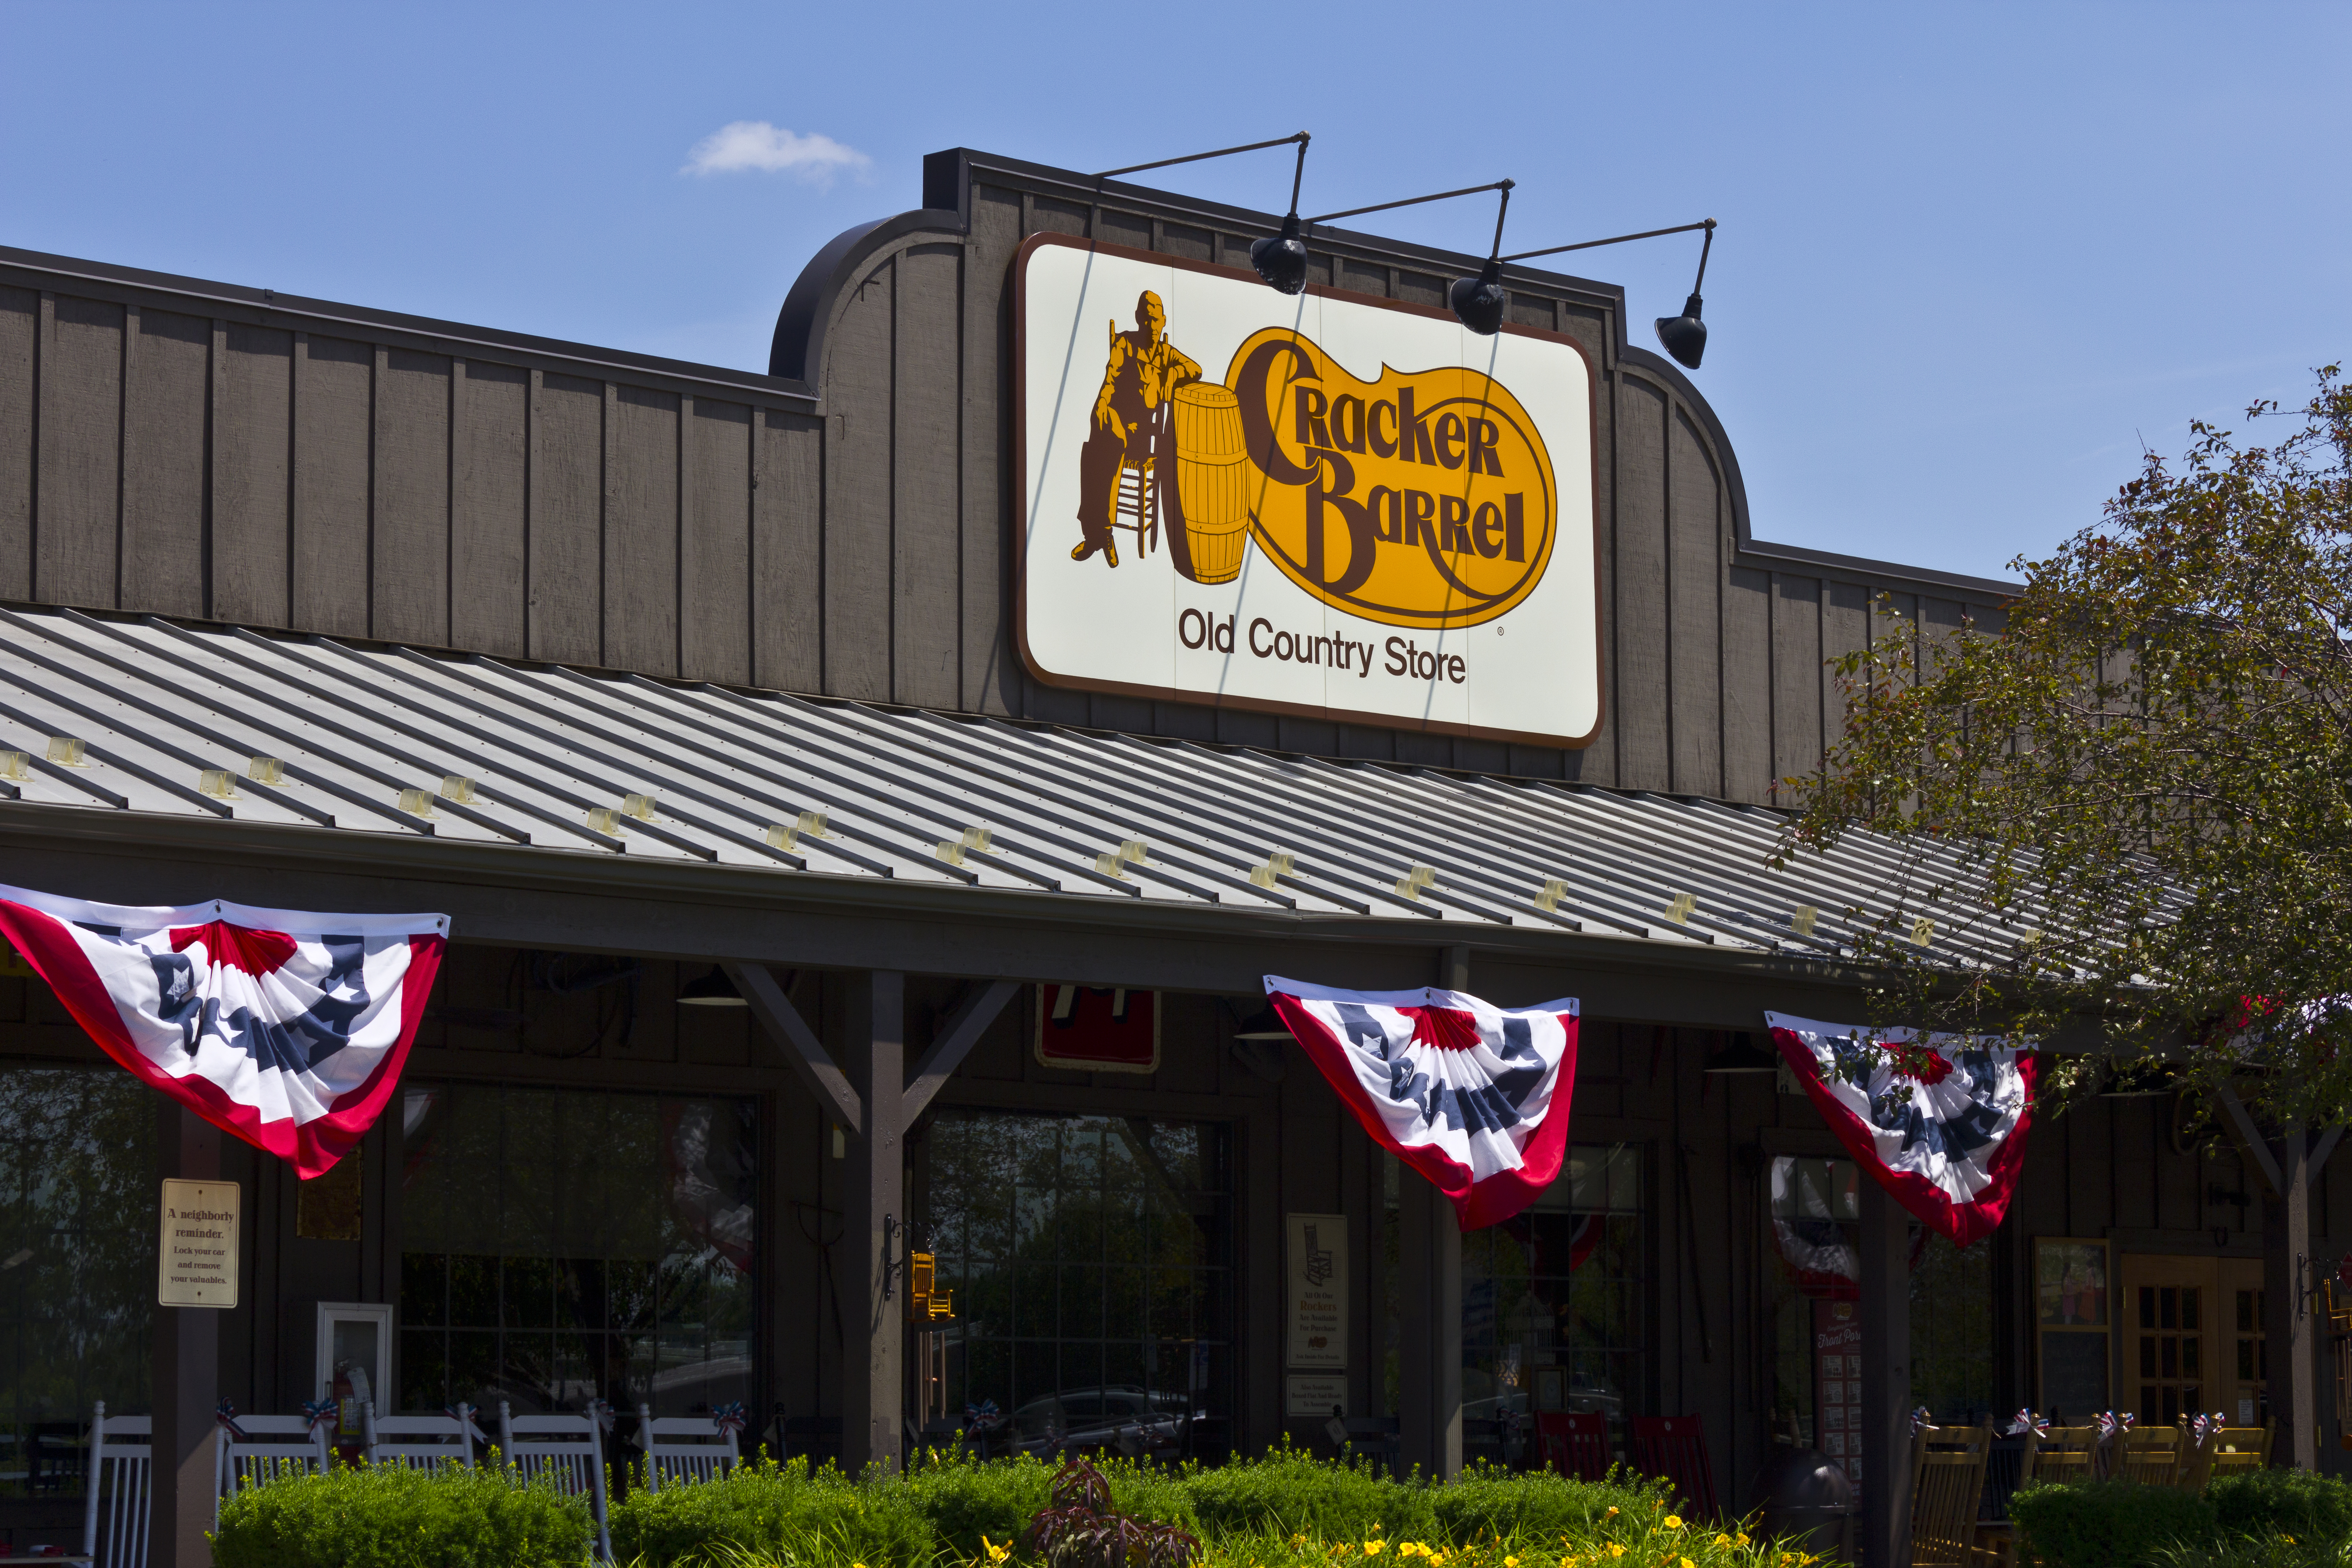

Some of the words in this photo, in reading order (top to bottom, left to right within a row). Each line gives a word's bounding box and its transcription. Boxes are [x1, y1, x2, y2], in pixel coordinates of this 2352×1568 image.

[1234, 339, 1505, 485] Cracker
[1303, 446, 1526, 600] Barrel
[1179, 608, 1235, 653] Old
[1249, 617, 1374, 678] Country
[1384, 636, 1466, 684] Store
[167, 1208, 176, 1218] A
[180, 1210, 234, 1224] neighborly
[175, 1229, 224, 1239] reminder.
[174, 1246, 193, 1254] Lock
[194, 1248, 212, 1256] your
[1300, 1300, 1337, 1311] Rockers
[1818, 1332, 1843, 1349] Front
